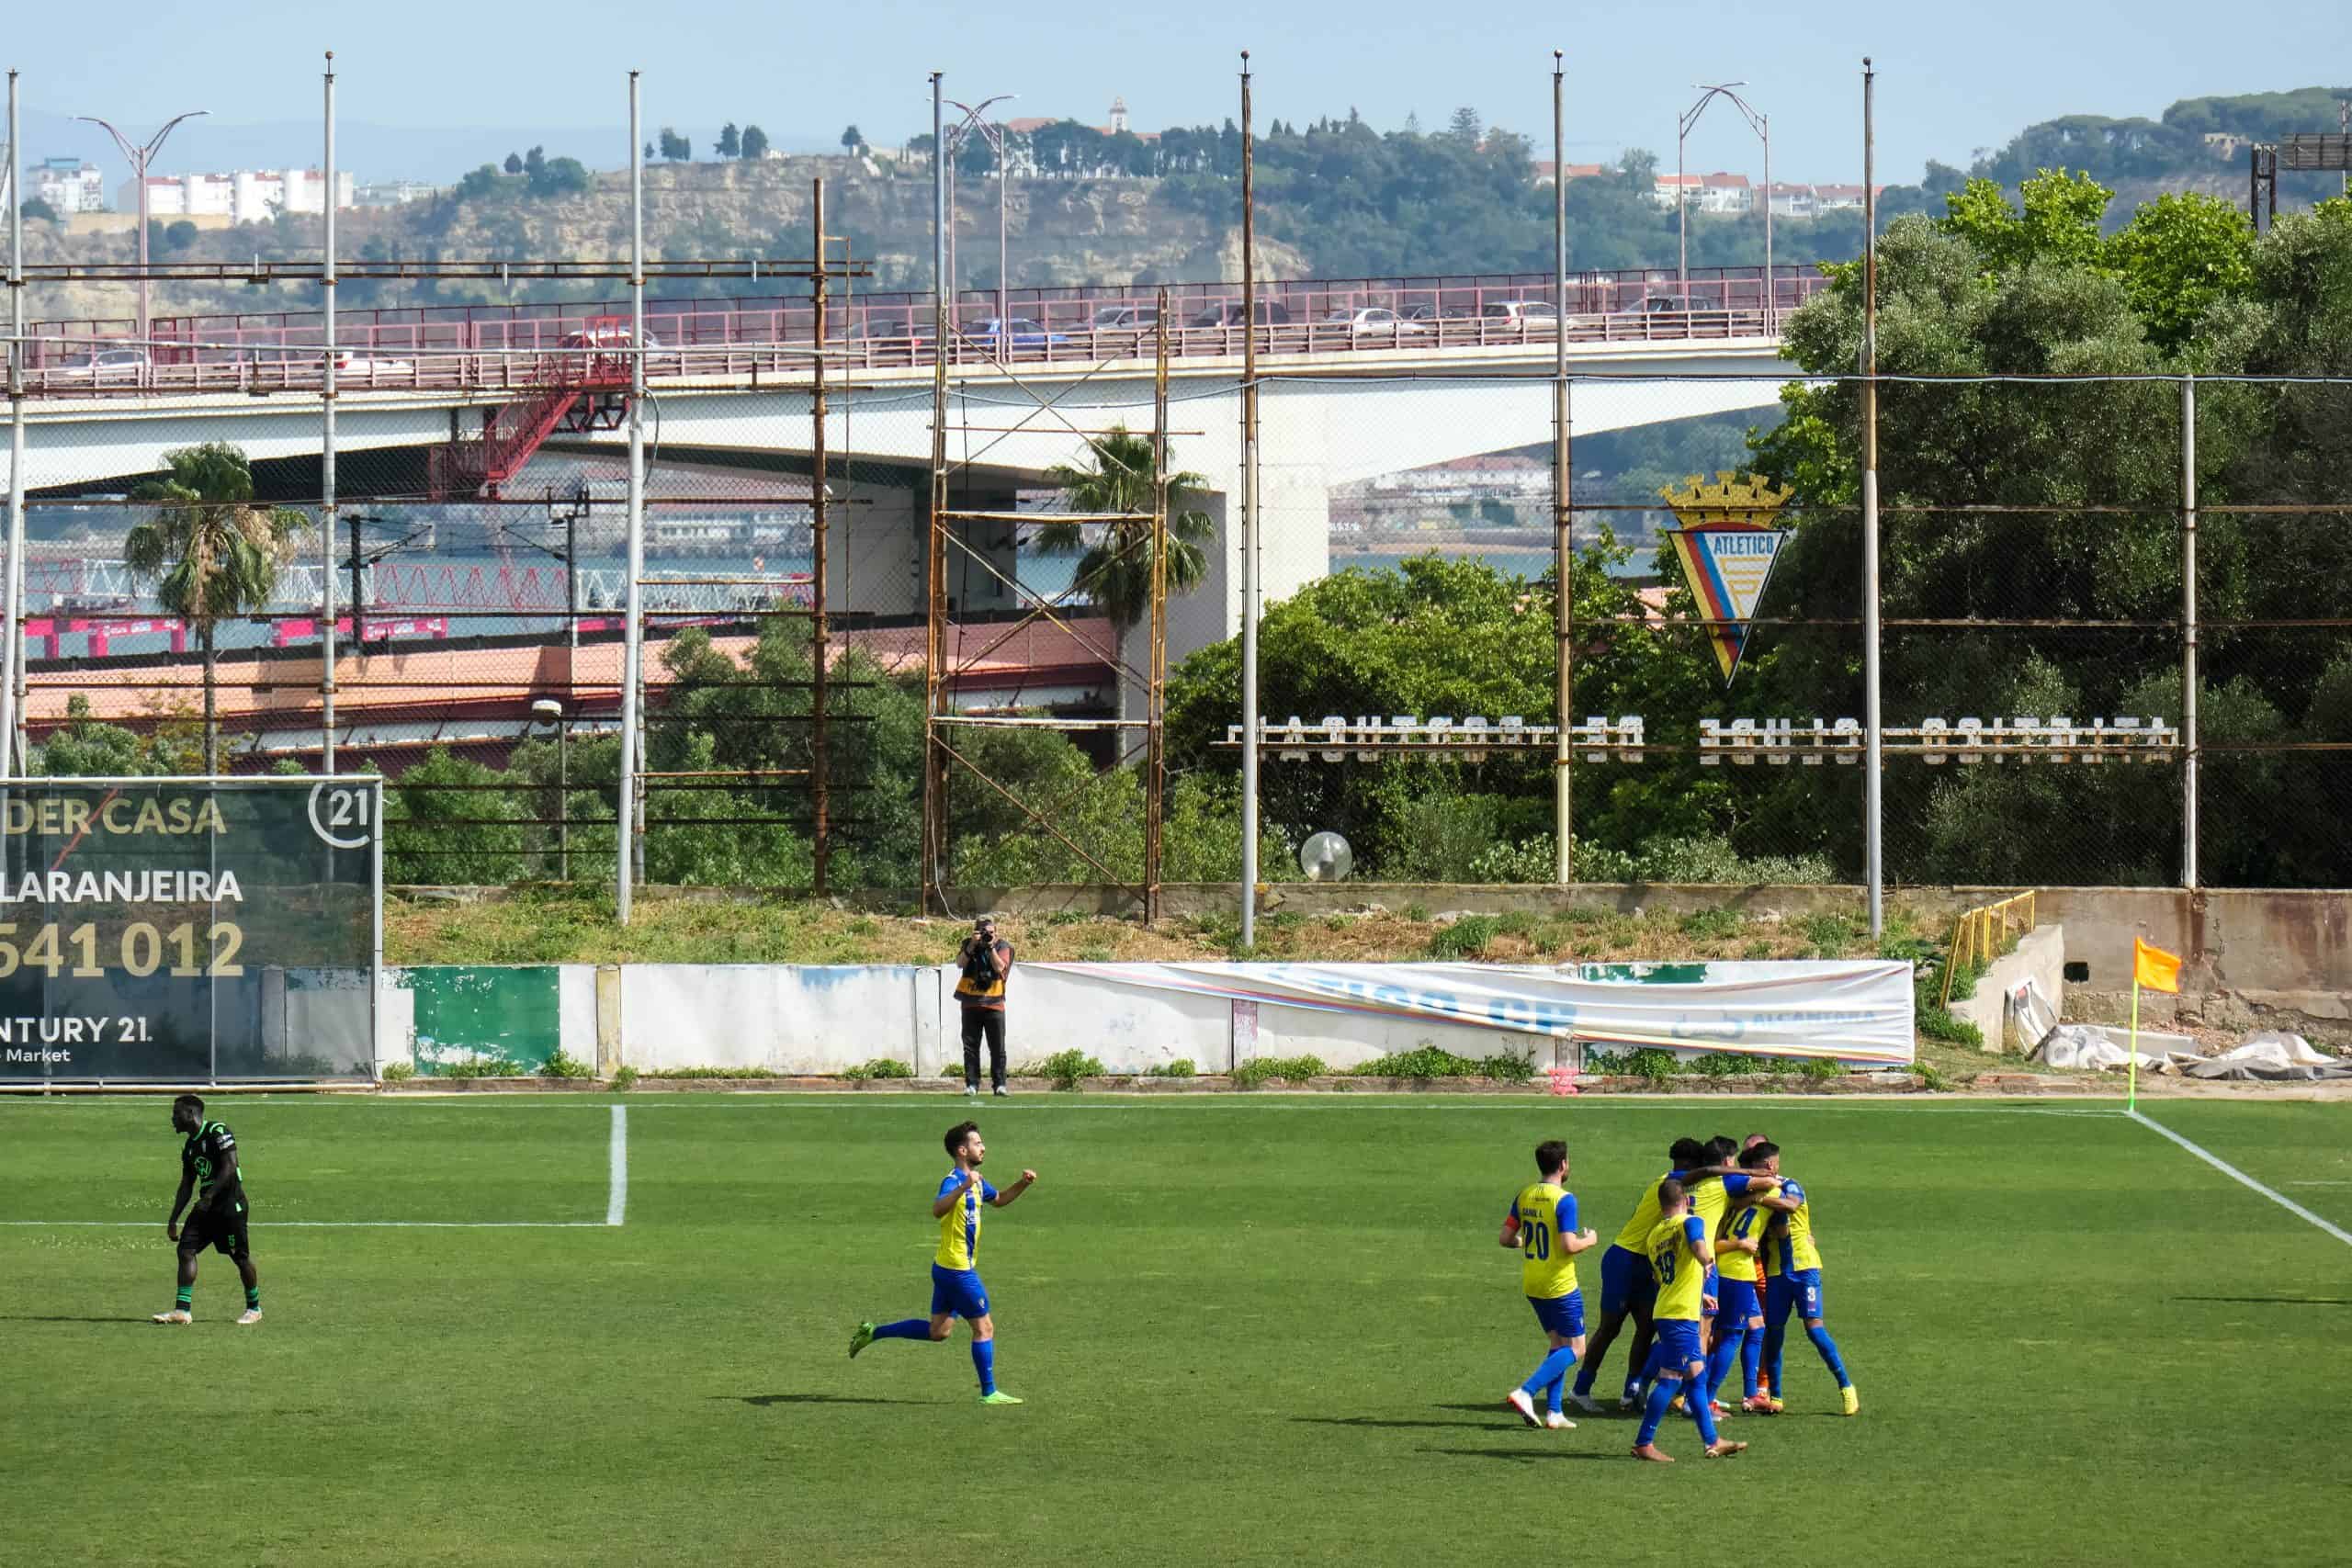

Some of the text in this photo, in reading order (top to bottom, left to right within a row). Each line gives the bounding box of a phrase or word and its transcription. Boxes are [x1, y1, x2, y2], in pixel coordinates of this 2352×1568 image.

[1713, 536, 1773, 555] ATLETICO
[102, 797, 227, 835] CASA
[329, 788, 368, 826] 21
[0, 870, 243, 903] LARANJEIRA
[0, 922, 244, 978] 541 012
[6, 1048, 71, 1063] Market
[1522, 1220, 1549, 1260] 20
